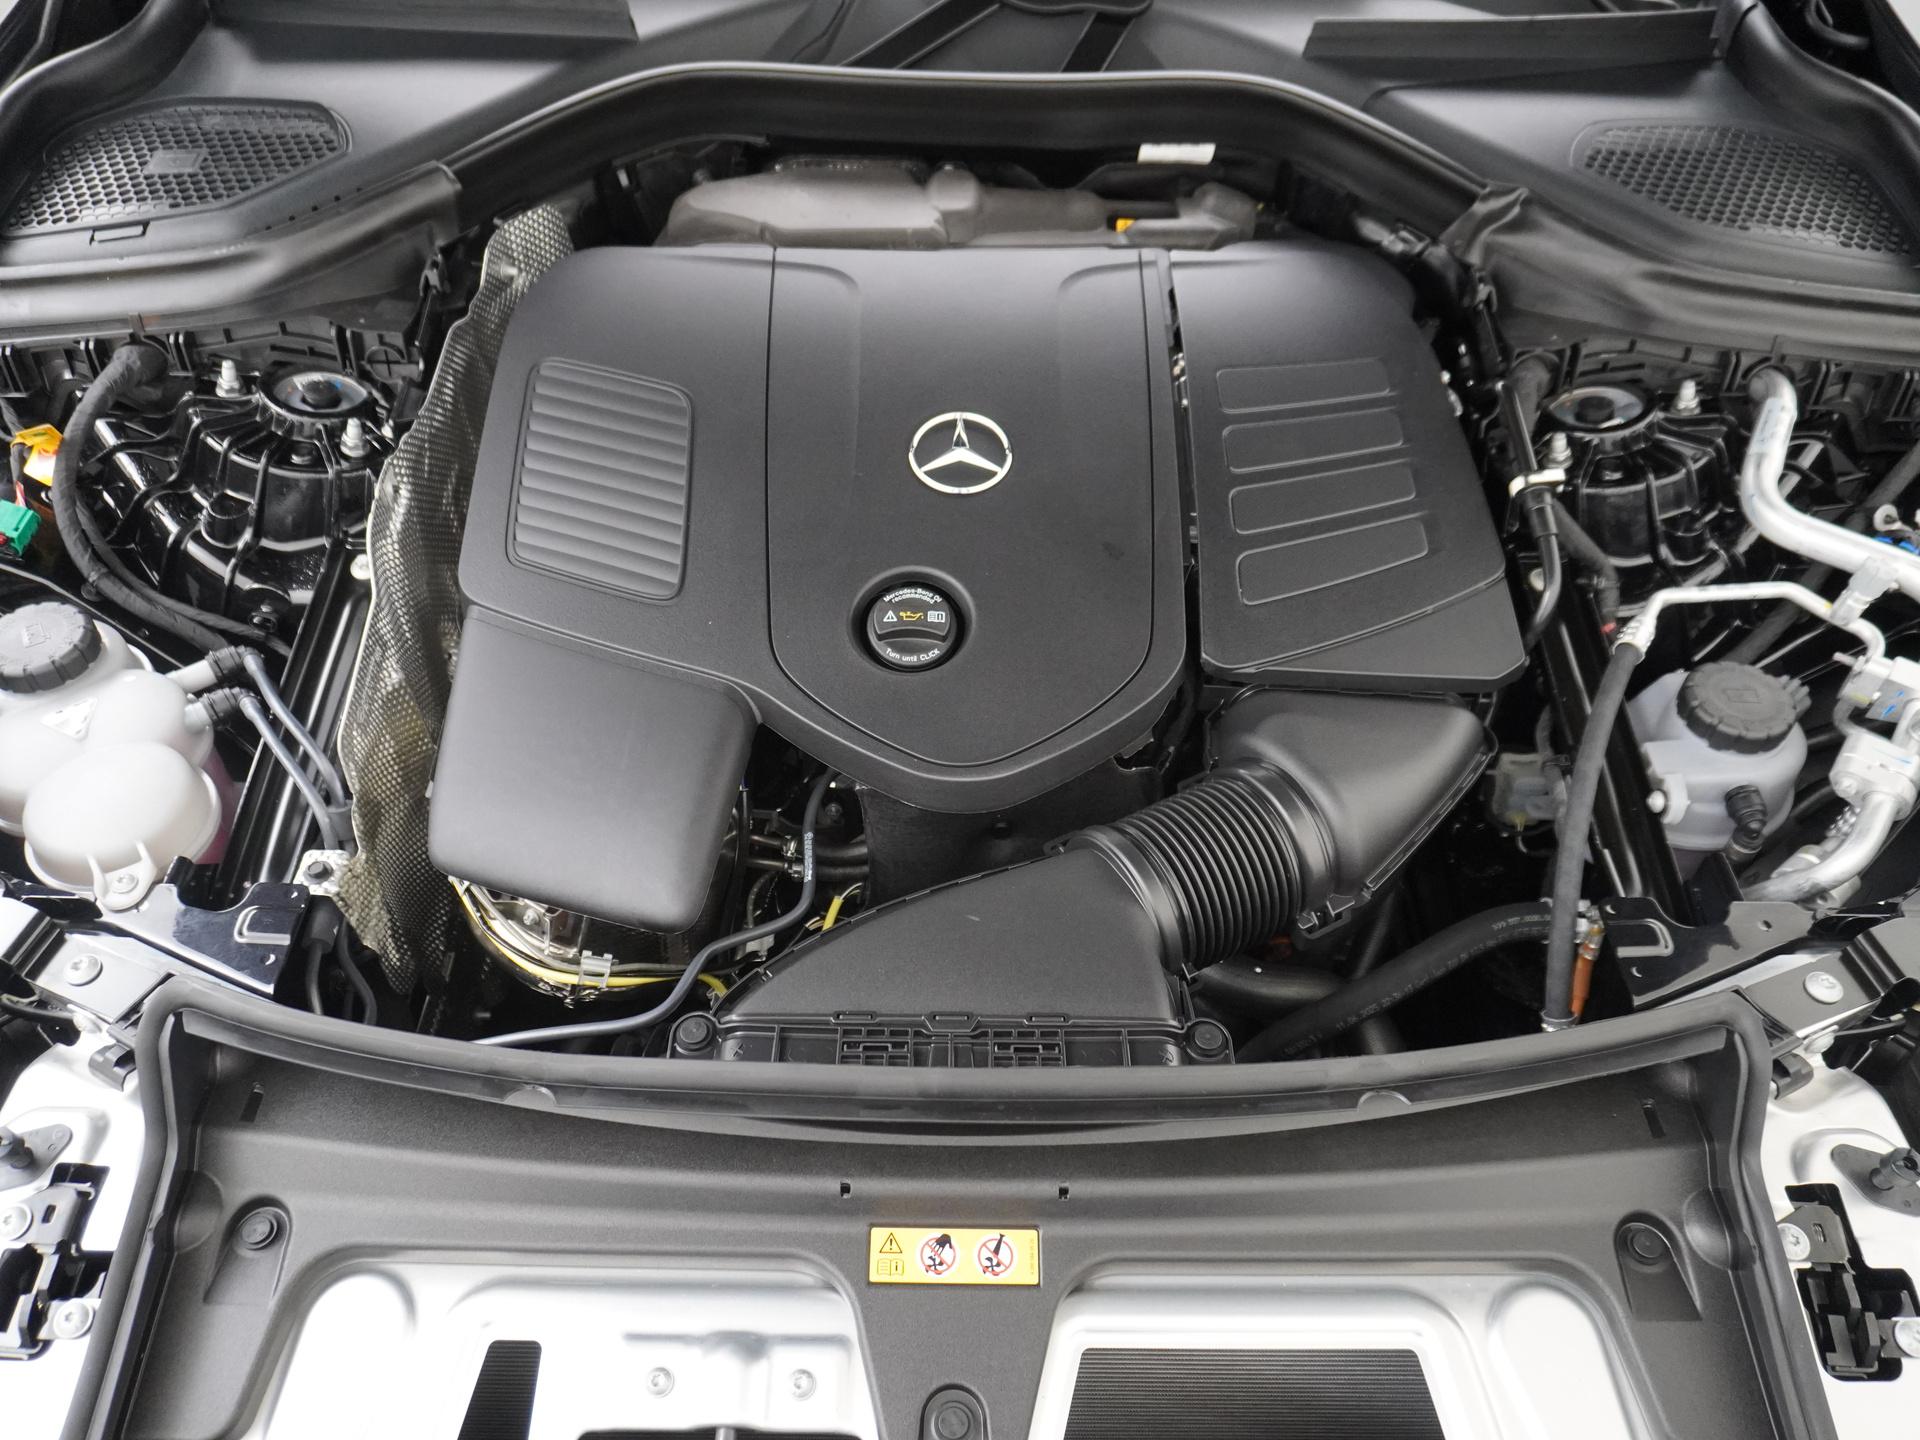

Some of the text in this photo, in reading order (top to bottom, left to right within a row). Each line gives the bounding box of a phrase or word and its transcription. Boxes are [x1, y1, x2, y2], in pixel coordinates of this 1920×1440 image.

[883, 588, 934, 602] Mercedes-Benz
[892, 593, 935, 604] recommended
[886, 647, 900, 659] Turn
[920, 648, 940, 661] CLICK
